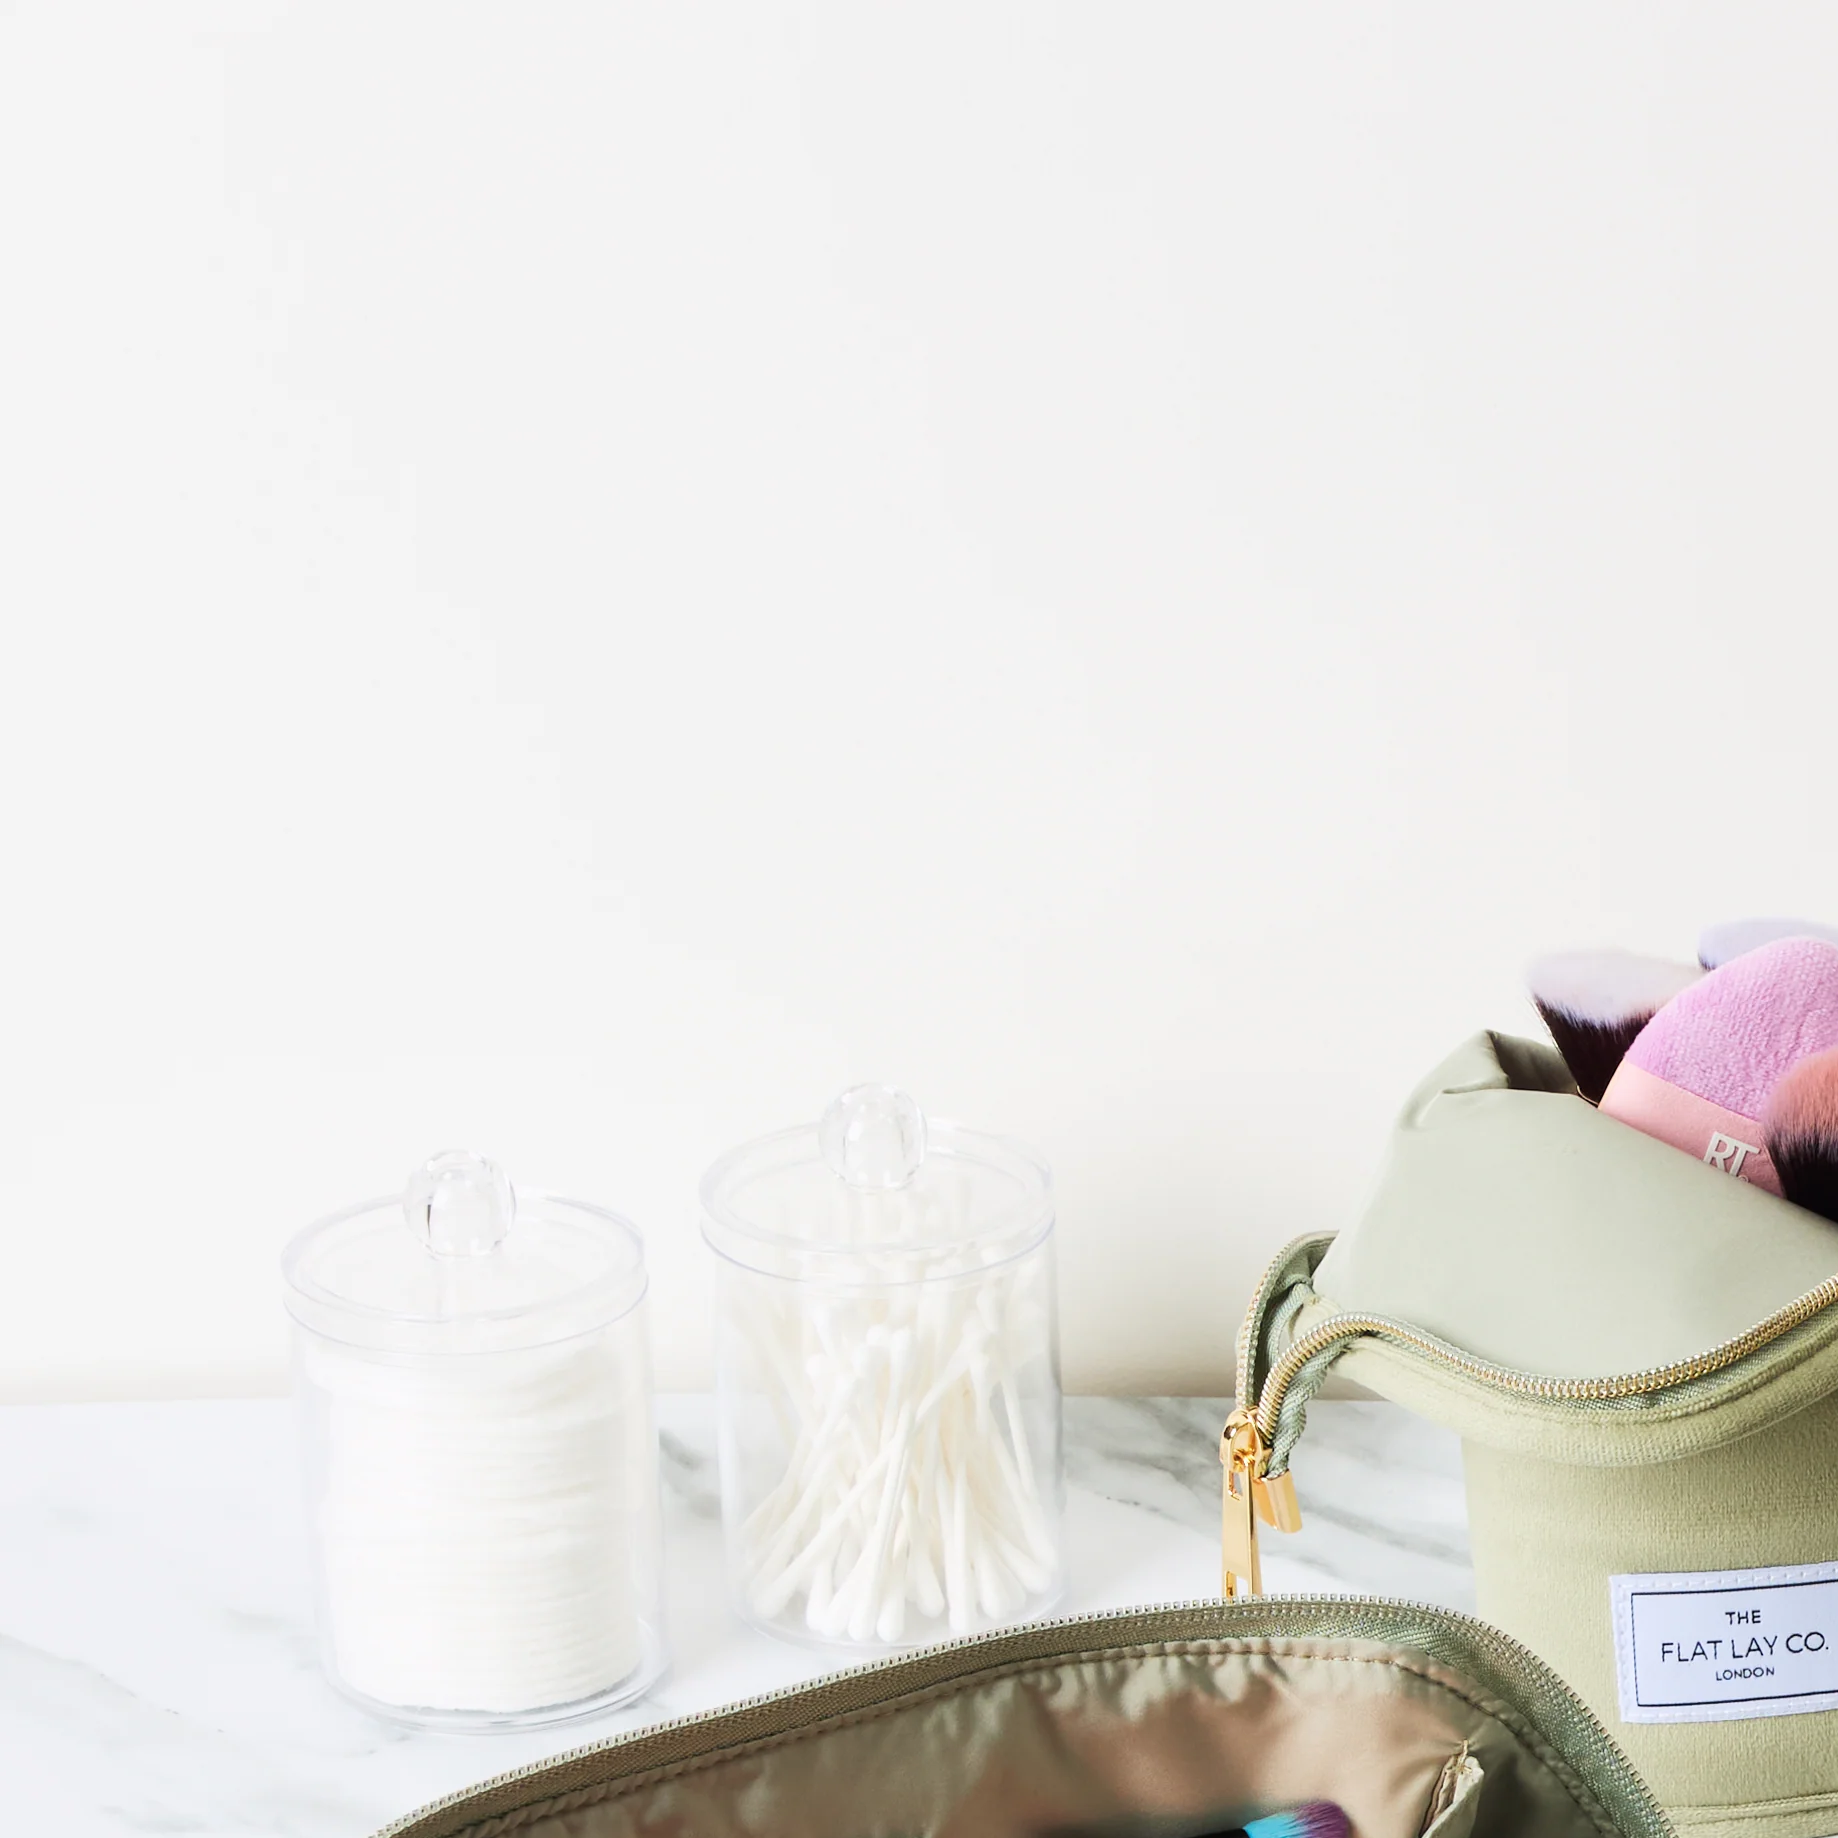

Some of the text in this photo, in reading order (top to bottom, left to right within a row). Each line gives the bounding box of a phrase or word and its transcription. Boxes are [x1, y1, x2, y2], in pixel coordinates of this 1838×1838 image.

[1724, 1610, 1762, 1625] THE
[1660, 1631, 1829, 1662] FLAT LAY CO.
[1715, 1666, 1775, 1682] LONDON
